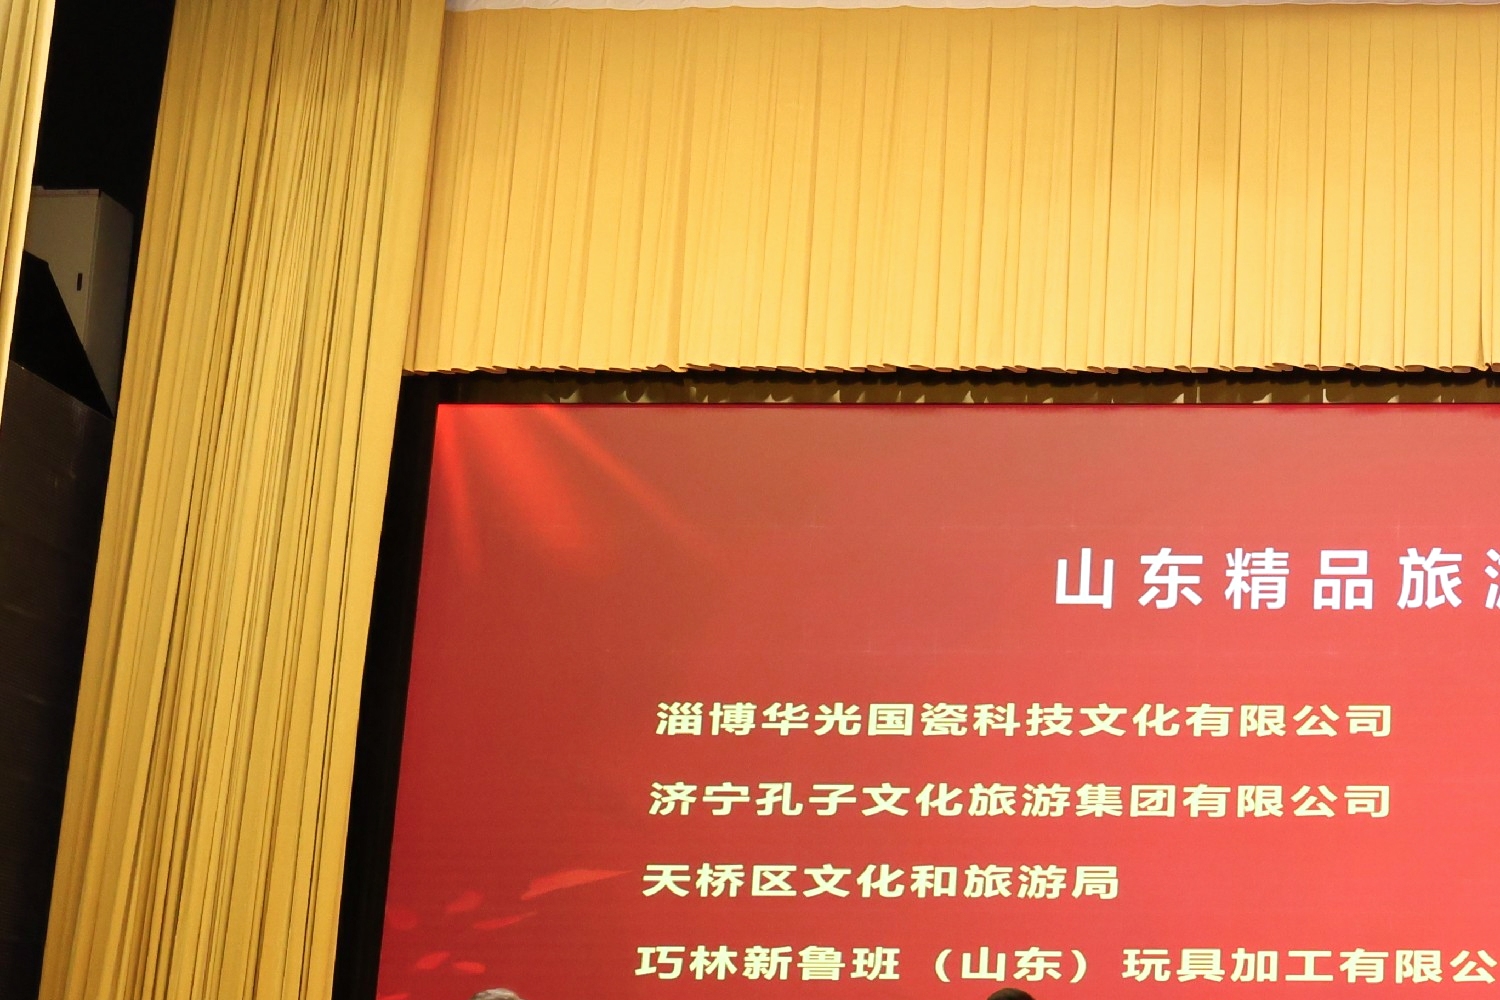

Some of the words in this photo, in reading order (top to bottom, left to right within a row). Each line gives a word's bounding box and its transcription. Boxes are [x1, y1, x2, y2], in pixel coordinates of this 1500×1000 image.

[655, 701, 1392, 738] 淄博华光国瓷科技文化有限公司
[648, 781, 1391, 818] 济宁孔子文化旅游集团有限公司
[642, 862, 1120, 900] 天桥区文化和旅游局
